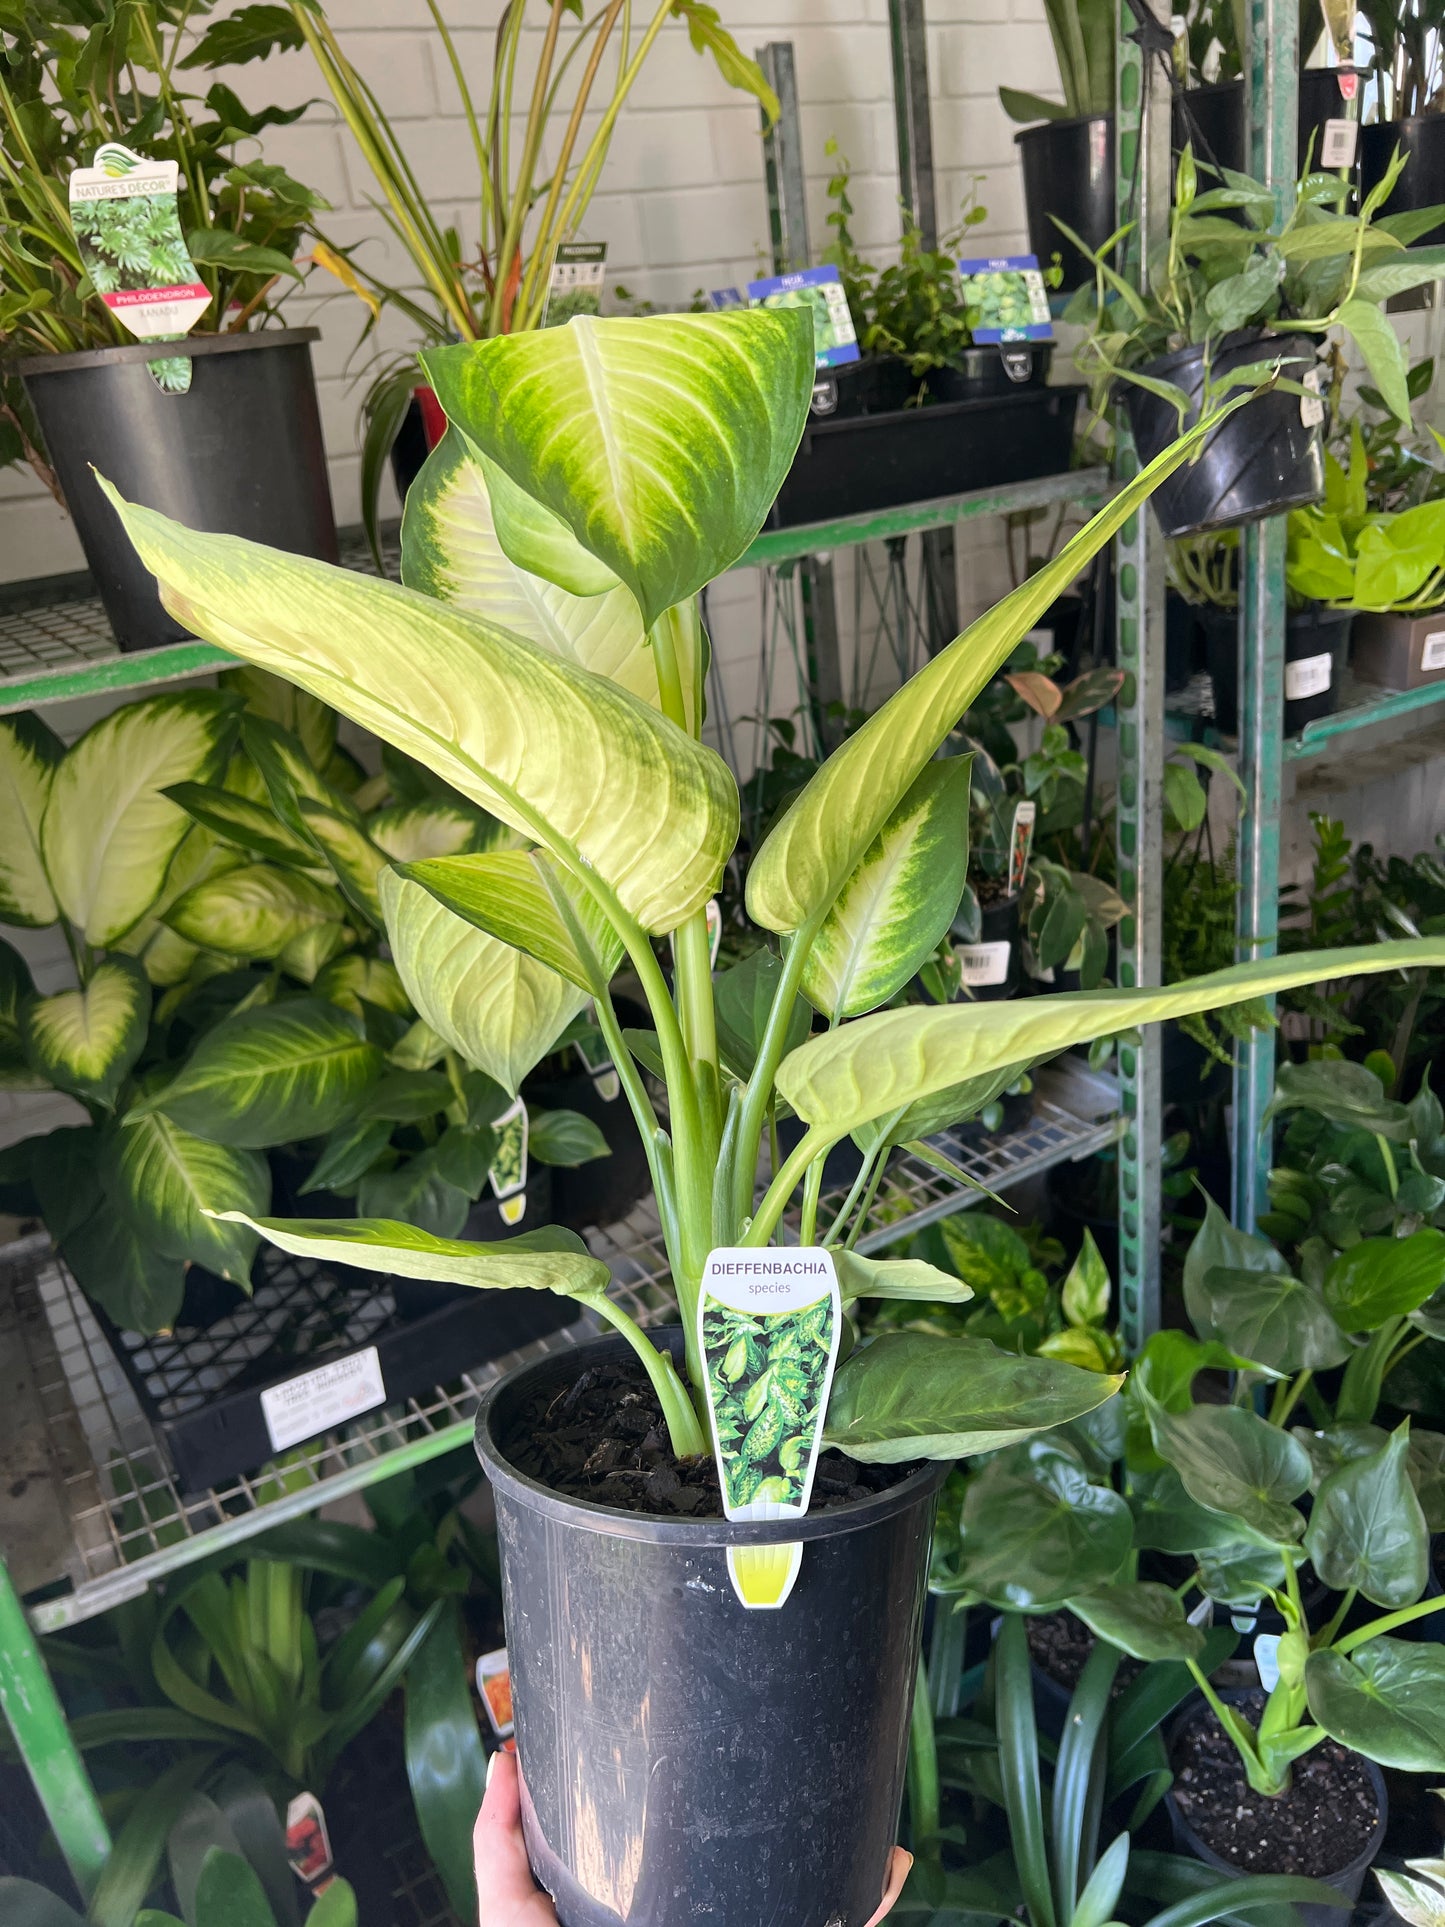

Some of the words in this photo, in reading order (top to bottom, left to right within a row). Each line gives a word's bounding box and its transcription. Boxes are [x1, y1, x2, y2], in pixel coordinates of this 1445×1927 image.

[75, 183, 126, 198] NATURE'S
[116, 288, 195, 304] PHILODENDRON
[711, 1262, 827, 1275] DIEFFENBACHIA
[748, 1282, 791, 1295] species
